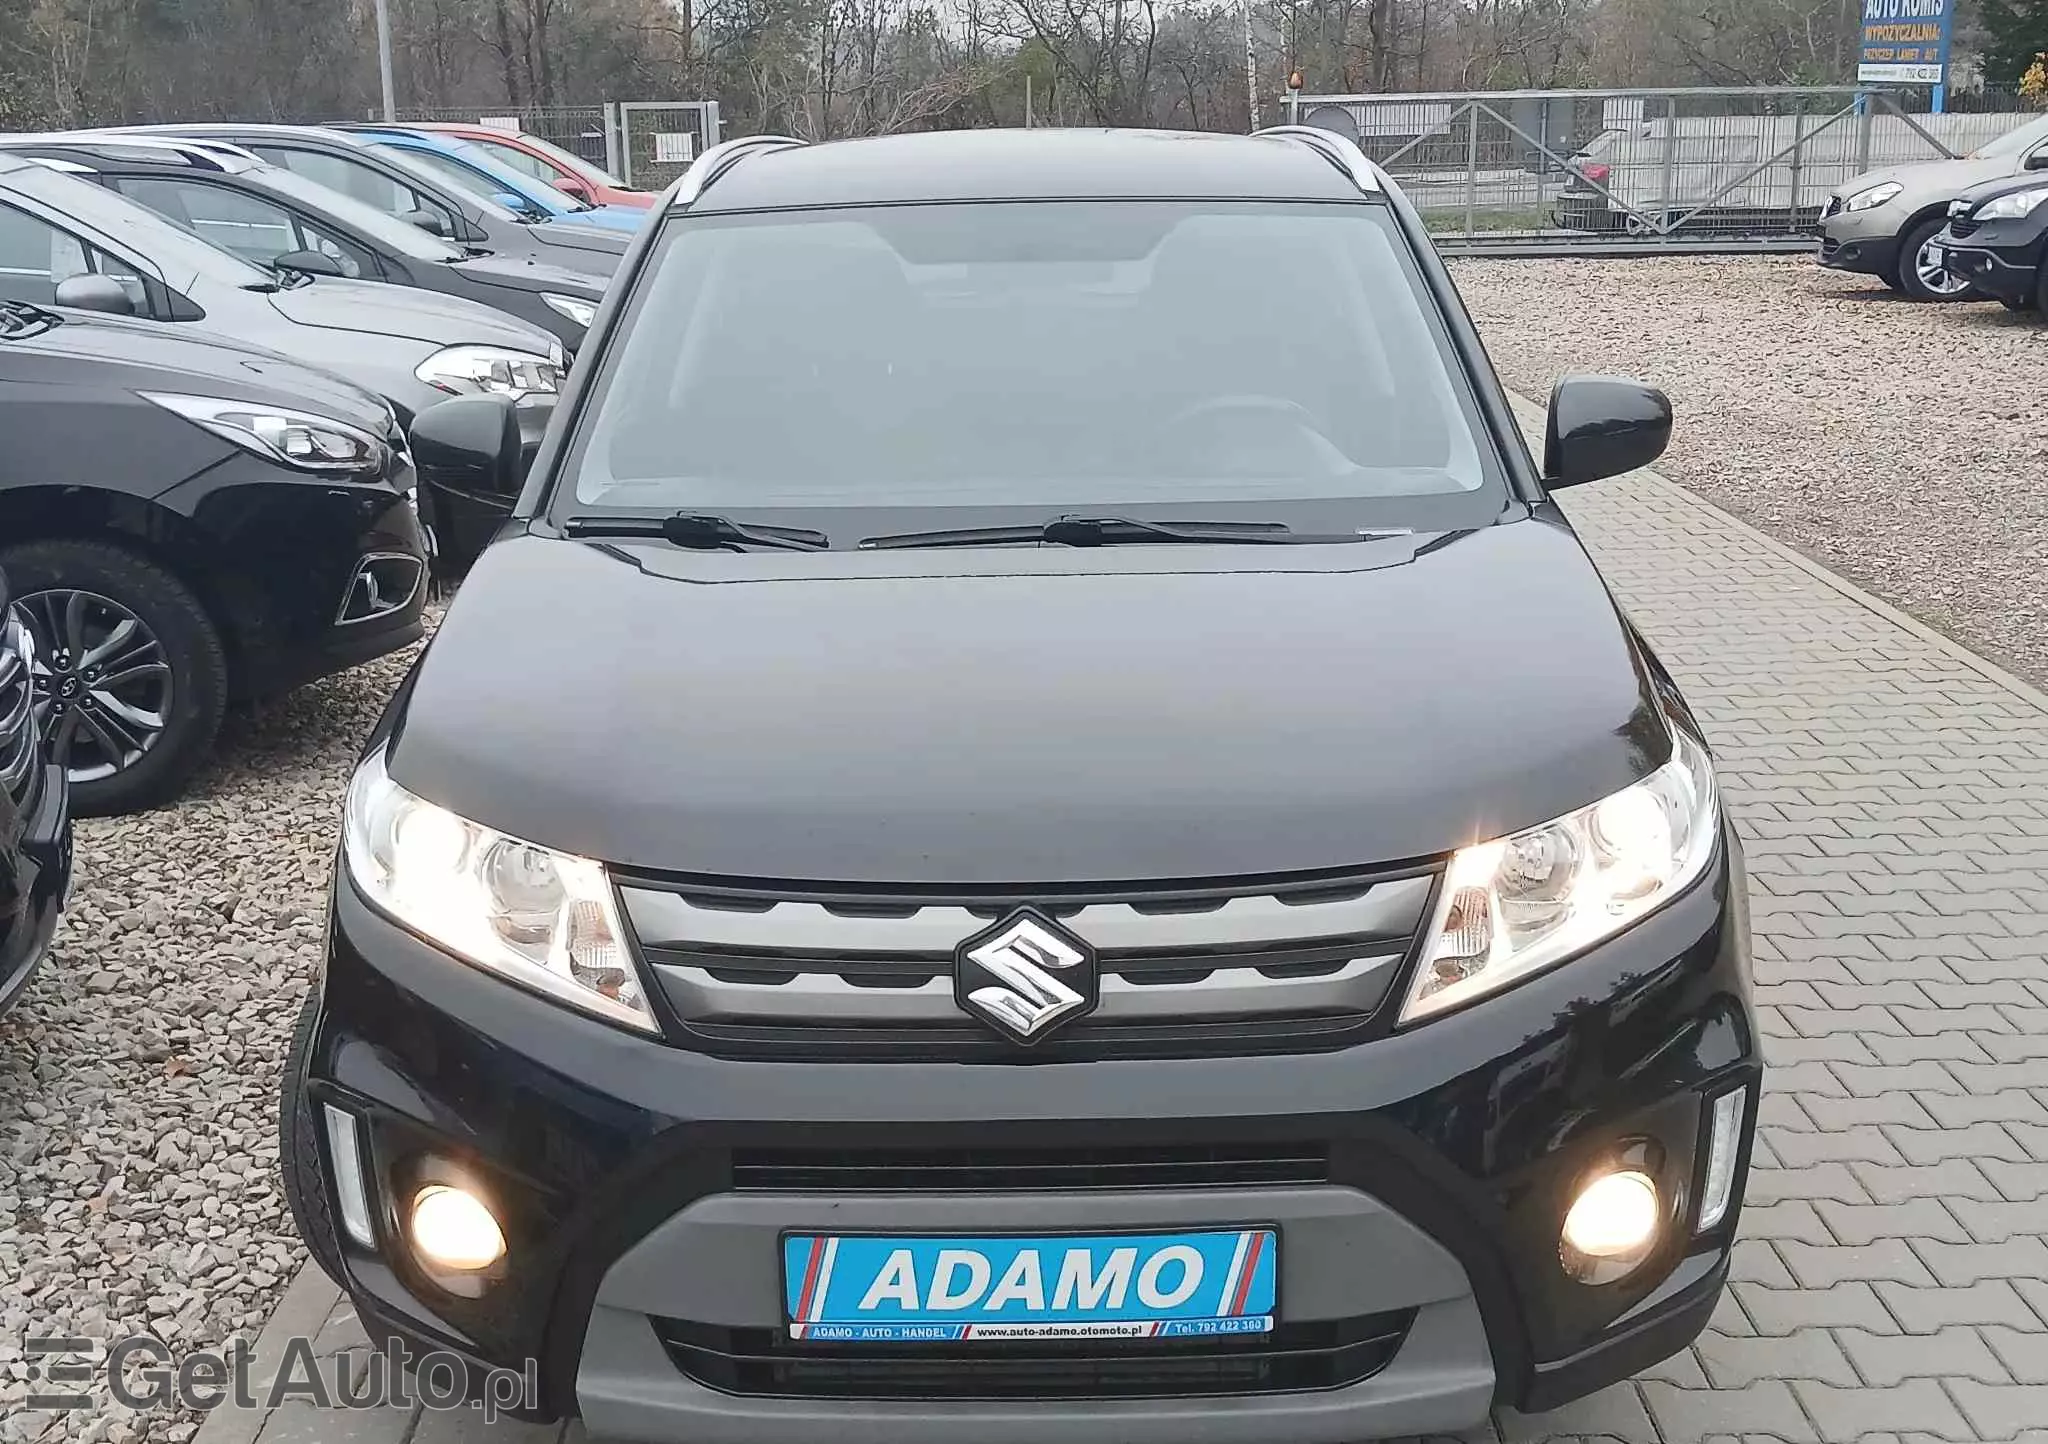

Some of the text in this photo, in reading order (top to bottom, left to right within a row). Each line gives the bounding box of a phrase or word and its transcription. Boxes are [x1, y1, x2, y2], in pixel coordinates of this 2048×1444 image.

[857, 1245, 1205, 1311] ADAMO
[812, 1326, 853, 1338] ADAMO
[862, 1326, 892, 1338] AUTO
[901, 1326, 946, 1338] HANDEL
[976, 1325, 1142, 1337] www.auto-adamo.otomoto.pl
[1175, 1323, 1194, 1334] Tel.
[1221, 1321, 1239, 1331] 422
